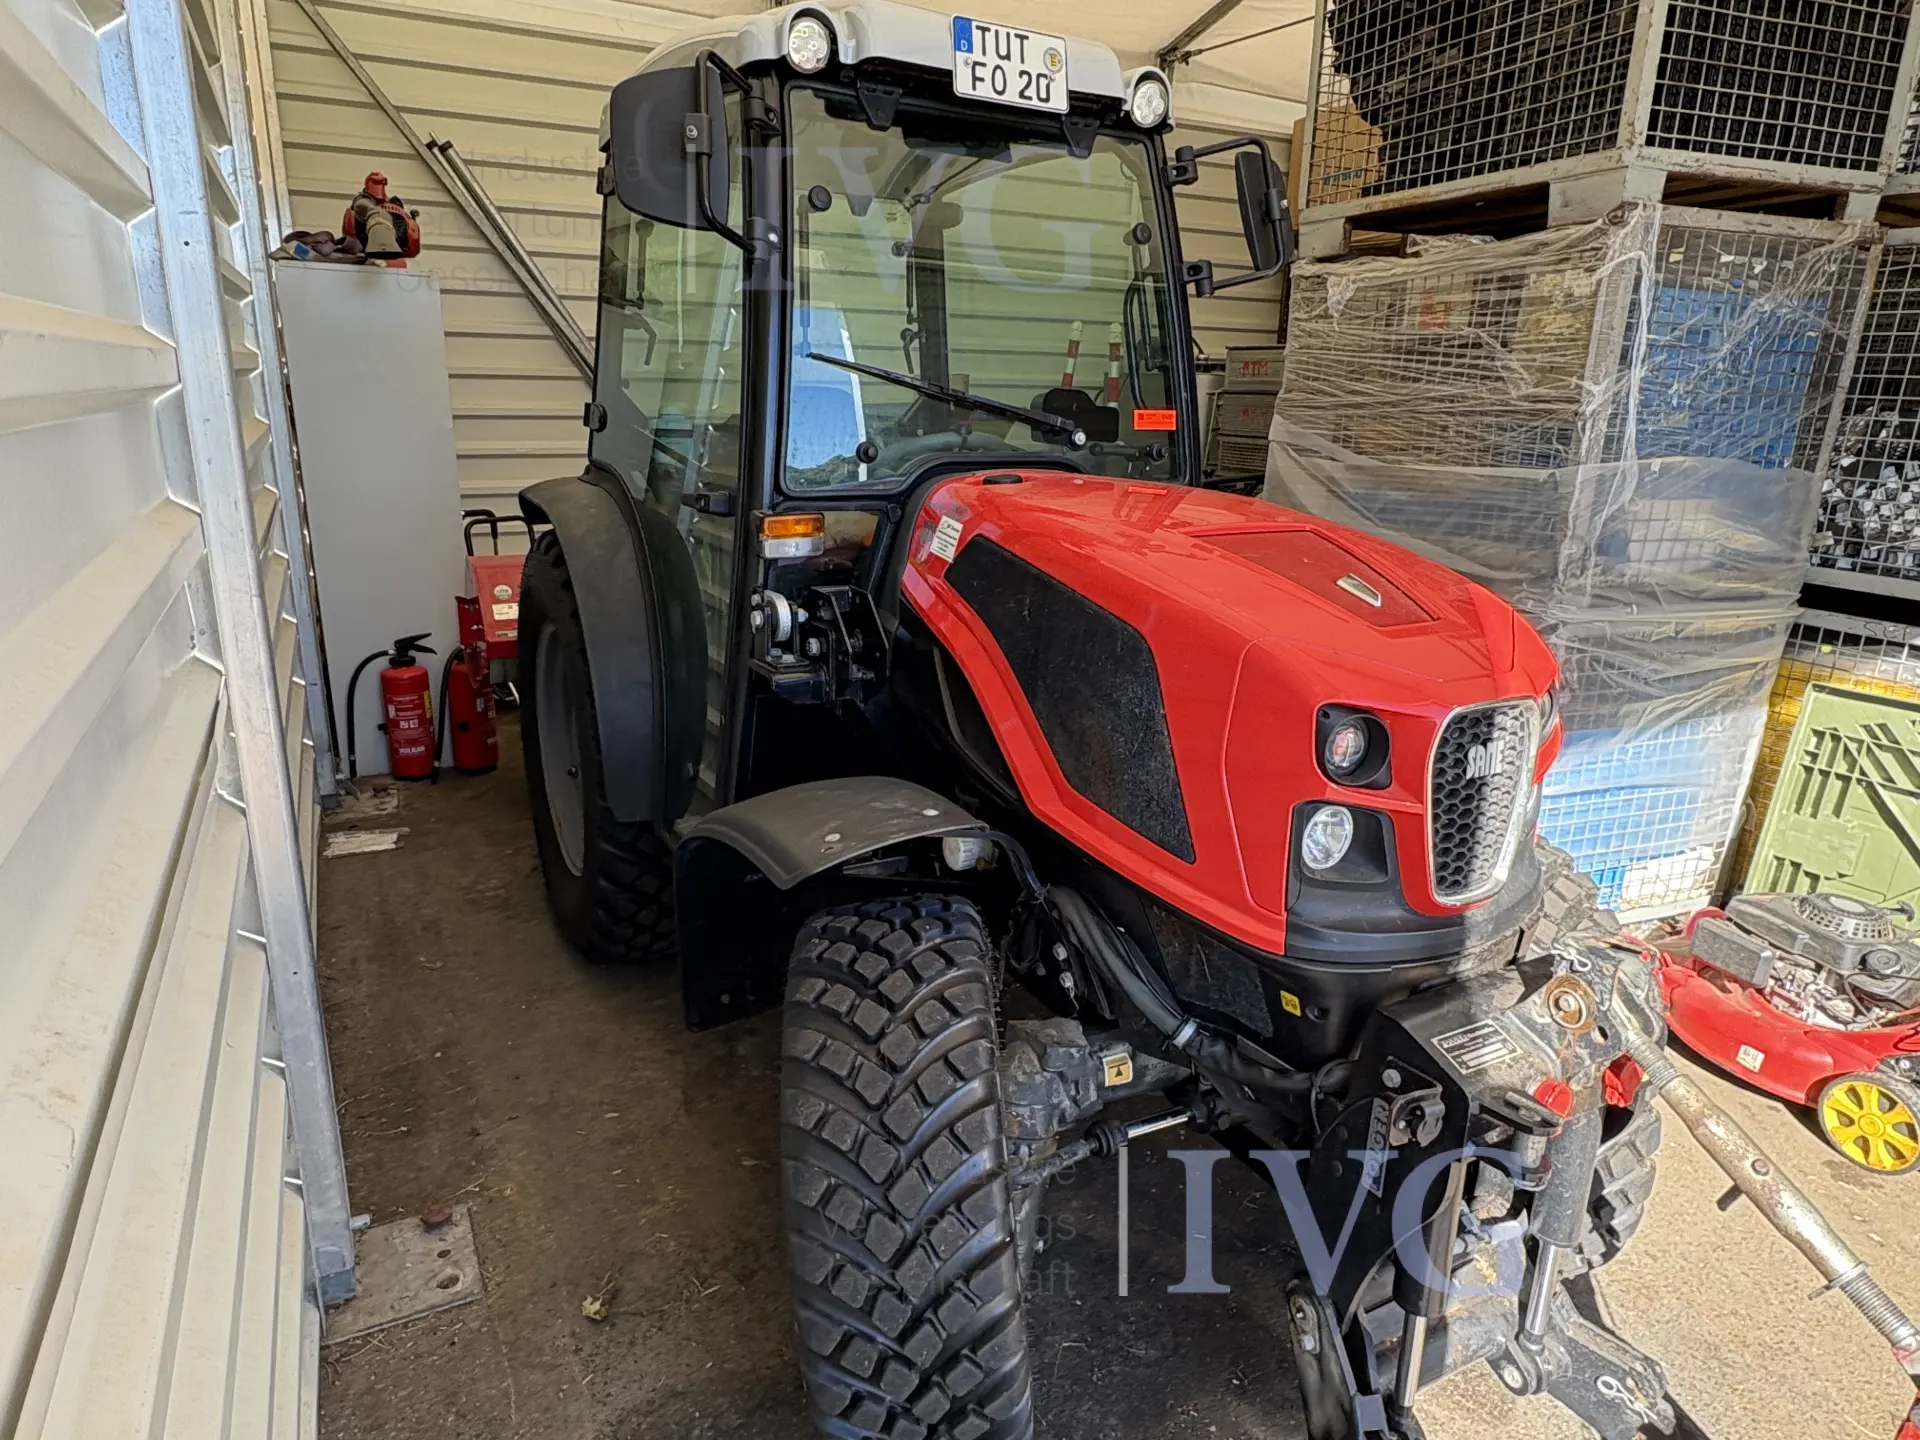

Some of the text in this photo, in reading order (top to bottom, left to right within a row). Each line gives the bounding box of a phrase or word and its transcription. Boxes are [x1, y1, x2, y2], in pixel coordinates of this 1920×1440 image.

[960, 39, 968, 51] D
[975, 24, 1030, 65] TUT
[970, 60, 1051, 104] FO 20
[1465, 739, 1505, 781] SAME
